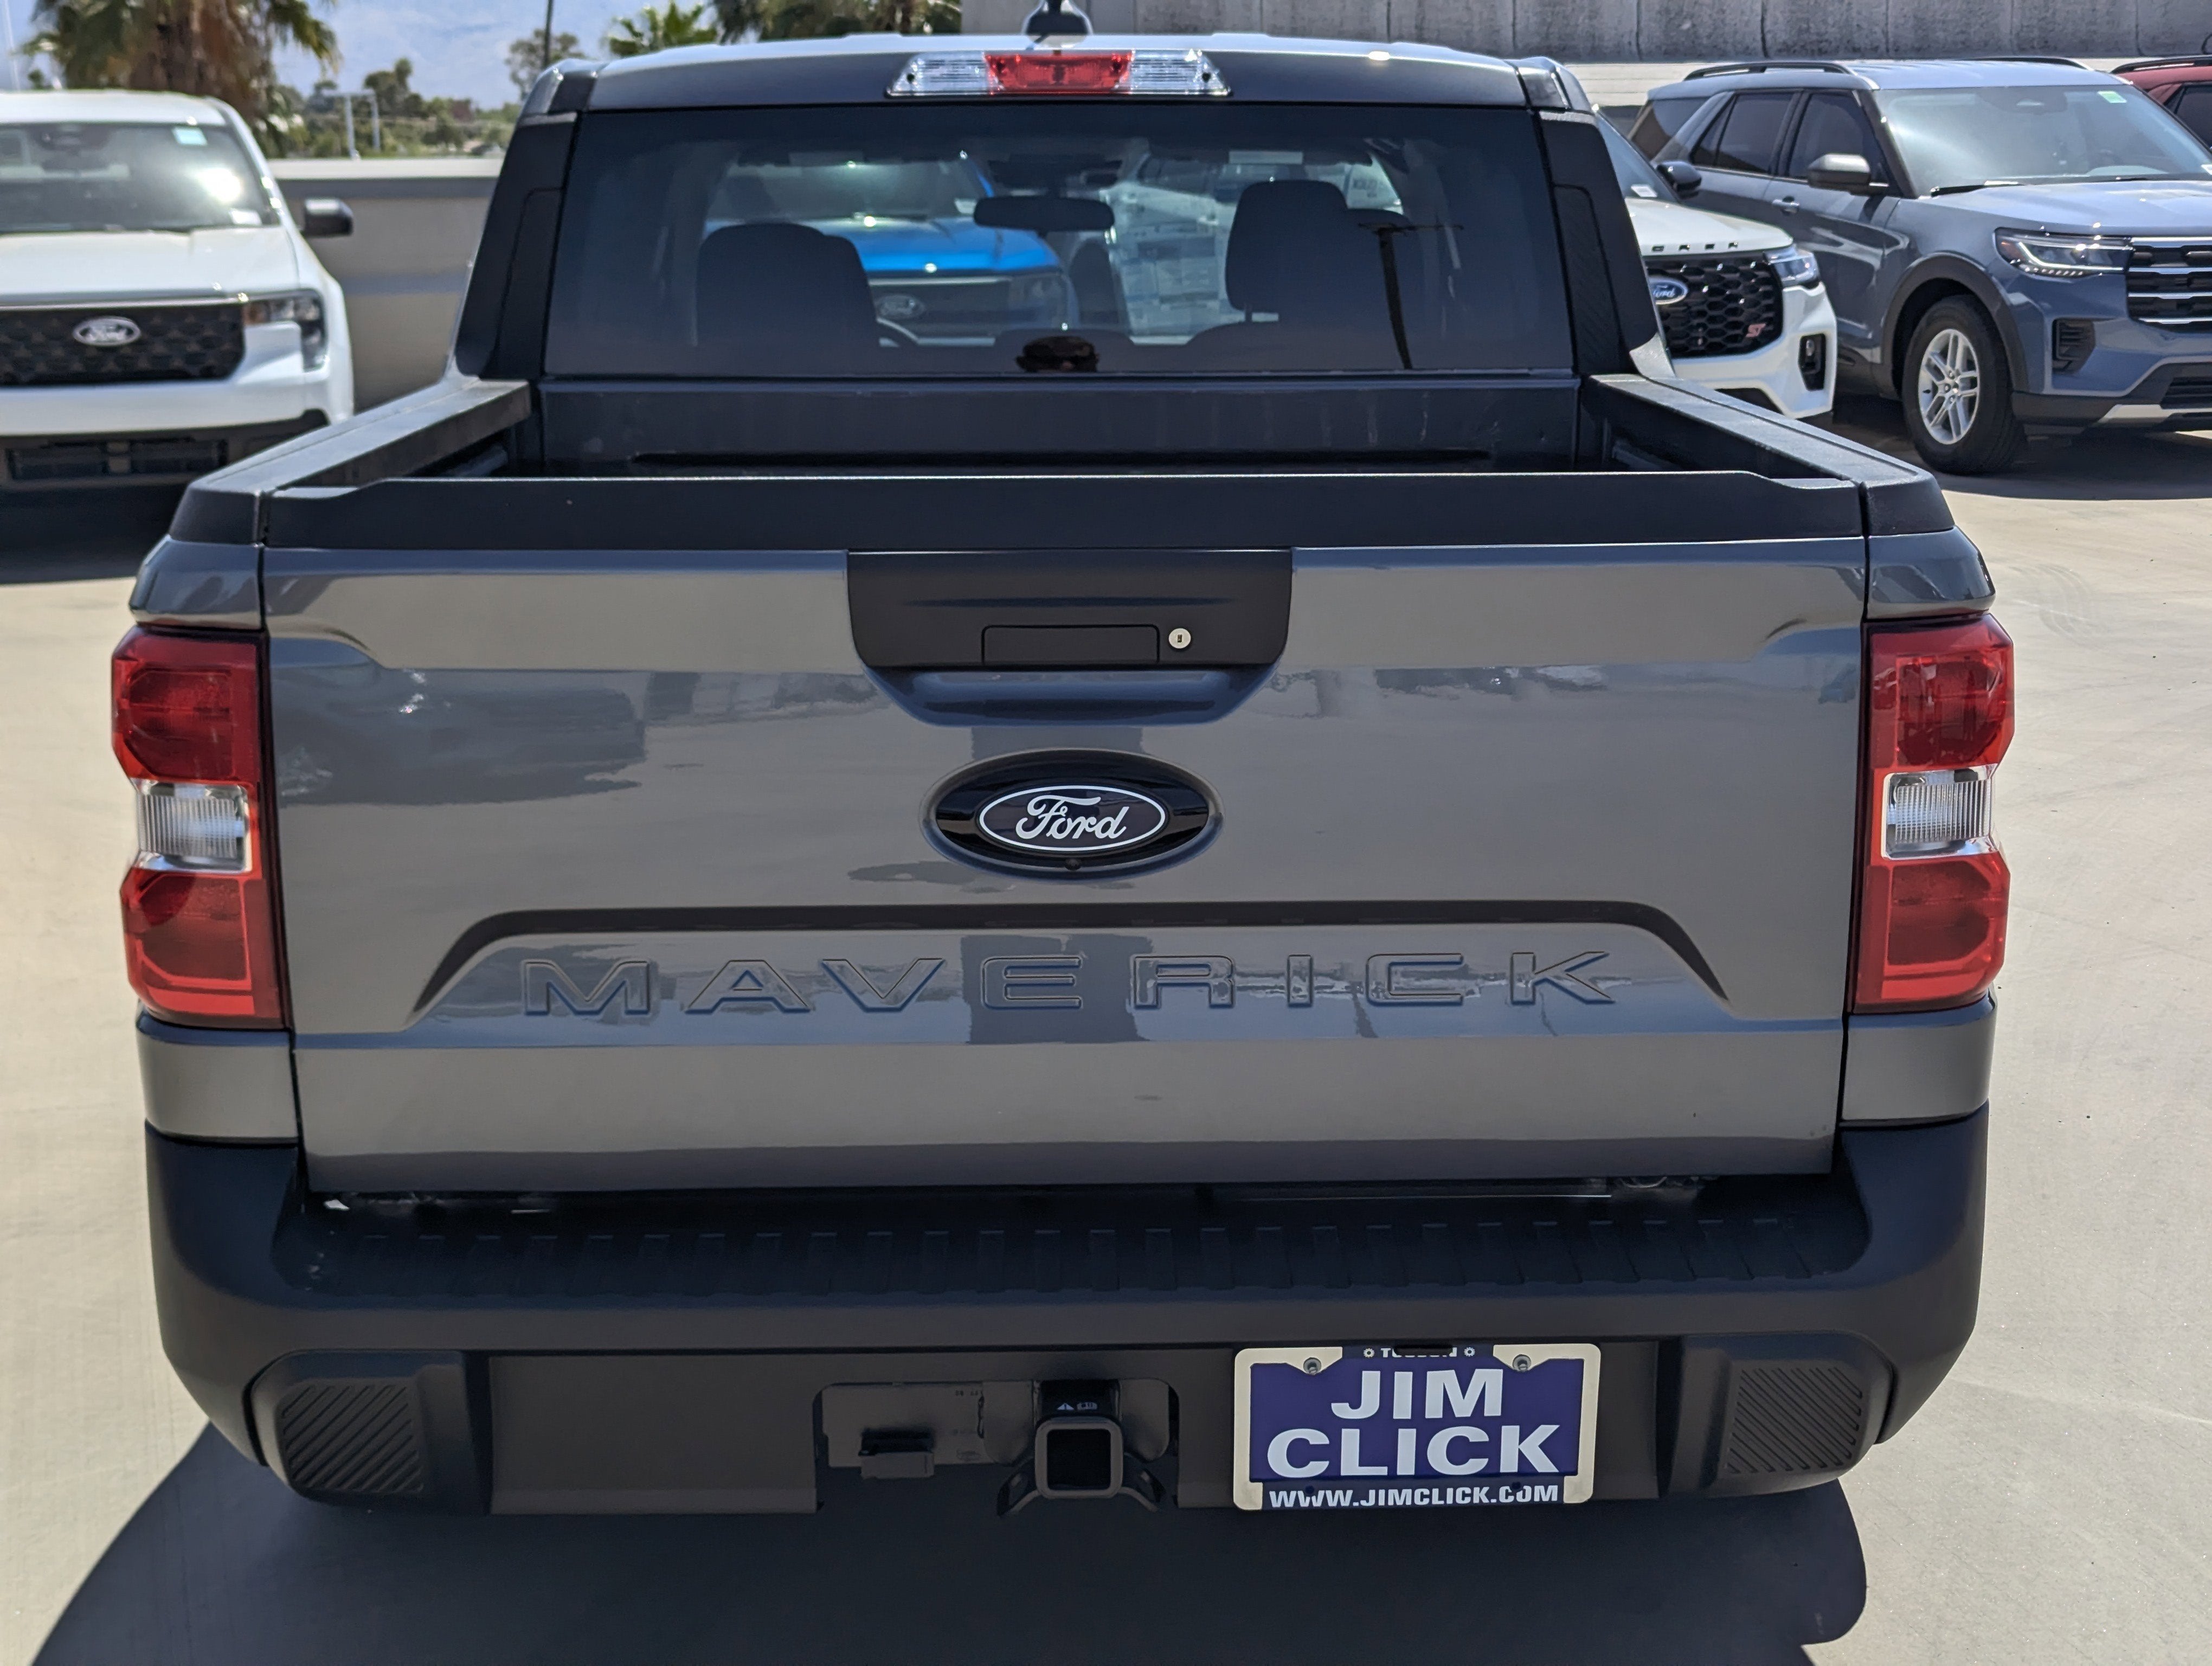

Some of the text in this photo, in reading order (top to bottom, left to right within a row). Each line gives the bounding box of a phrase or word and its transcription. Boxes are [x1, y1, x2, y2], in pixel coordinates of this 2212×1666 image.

[1015, 794, 1130, 840] Ford
[523, 950, 1616, 1015] MAVERICK
[1330, 1368, 1503, 1419] JIM
[1266, 1424, 1560, 1478] CLICK
[1269, 1484, 1559, 1508] WWW.JIMCLICK.COM
